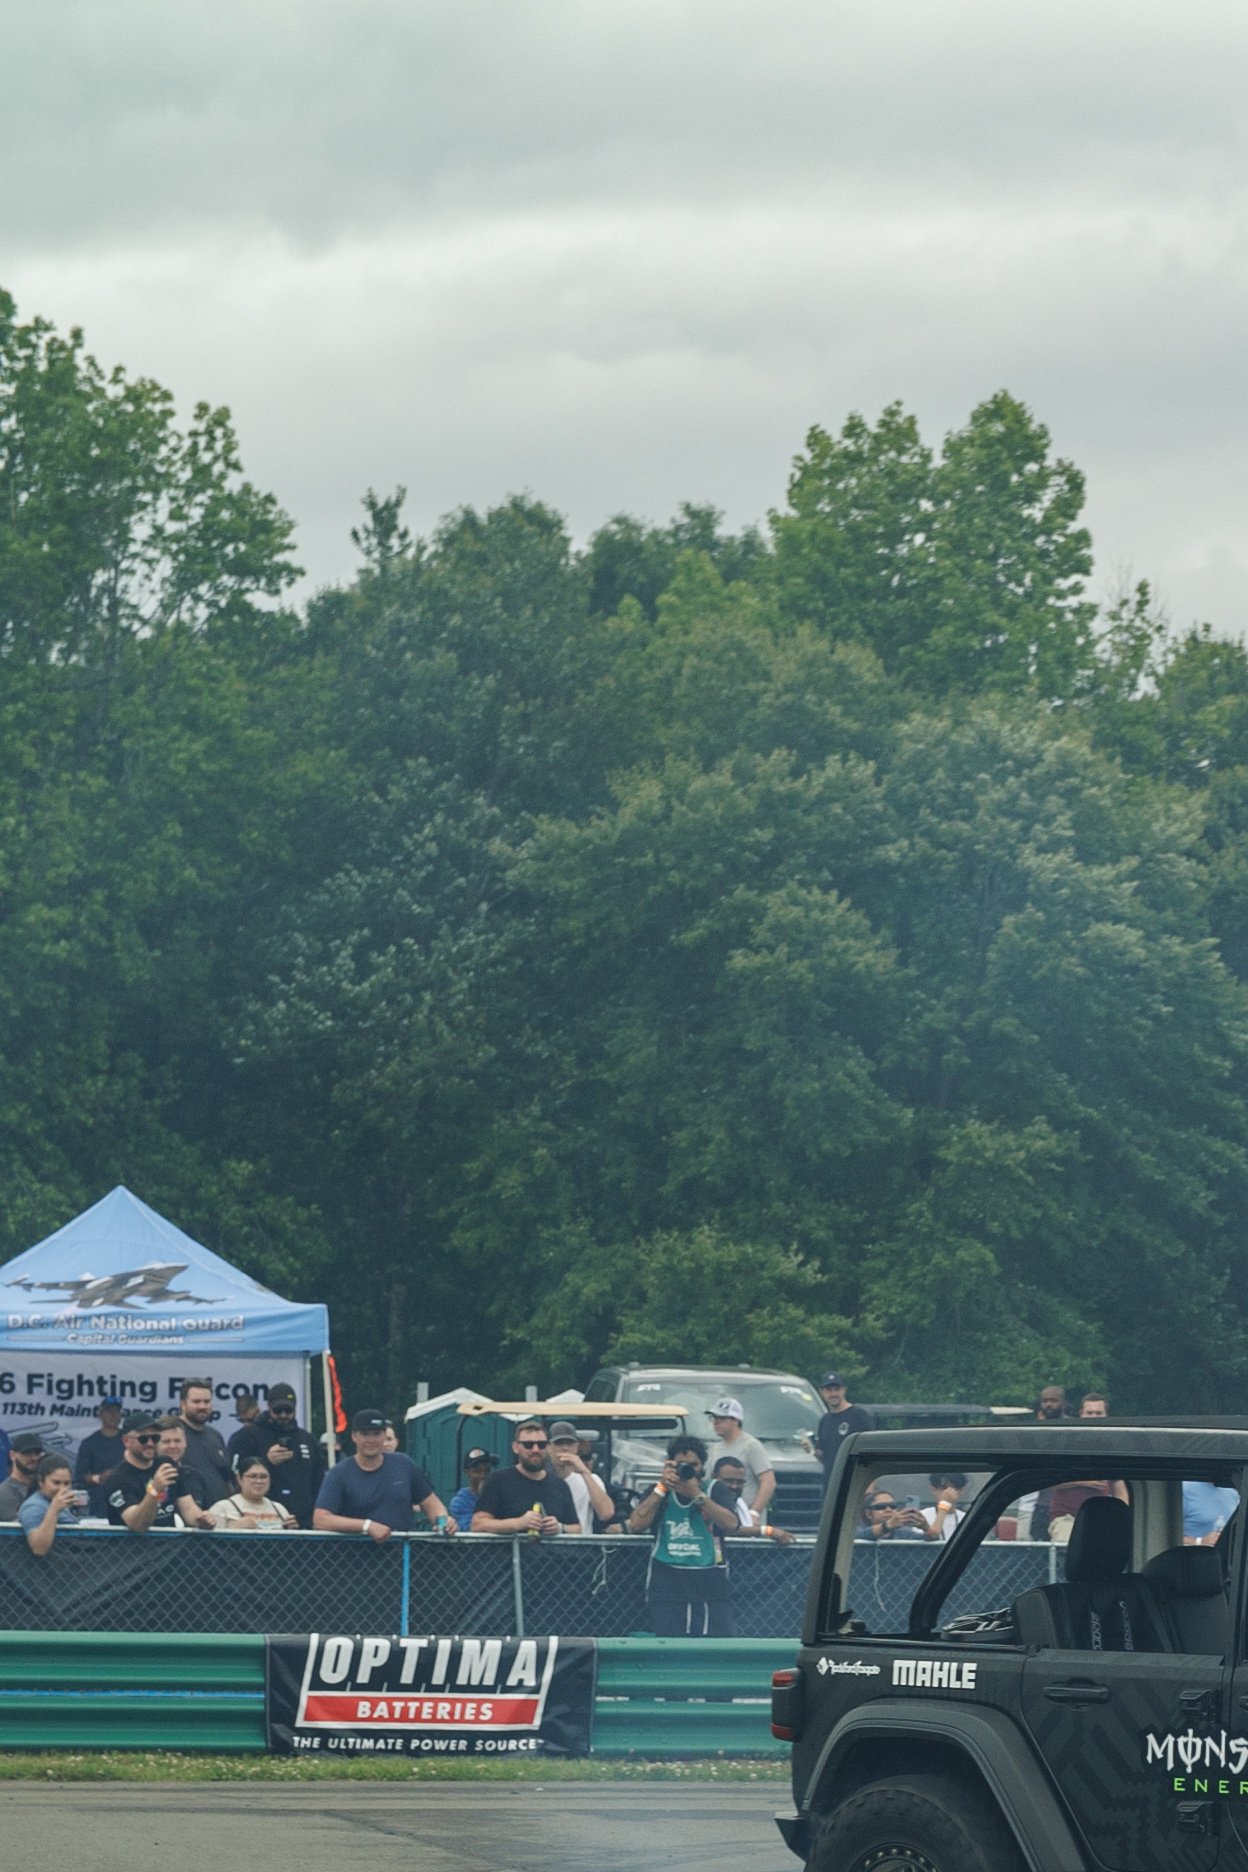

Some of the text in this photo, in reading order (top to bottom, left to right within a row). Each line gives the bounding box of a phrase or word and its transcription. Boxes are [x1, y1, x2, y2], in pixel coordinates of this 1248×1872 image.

[7, 1314, 245, 1331] D.C. Air National Guard
[66, 1333, 184, 1345] Capital Guardians
[26, 1372, 158, 1403] Fighting
[2, 1402, 46, 1417] 113th
[318, 1636, 537, 1687] OPTIMA
[892, 1659, 977, 1689] MAHLE
[356, 1701, 494, 1722] BATTERIES
[292, 1735, 321, 1749] THE
[327, 1736, 404, 1750] ULTIMATE
[409, 1738, 468, 1751] POWER
